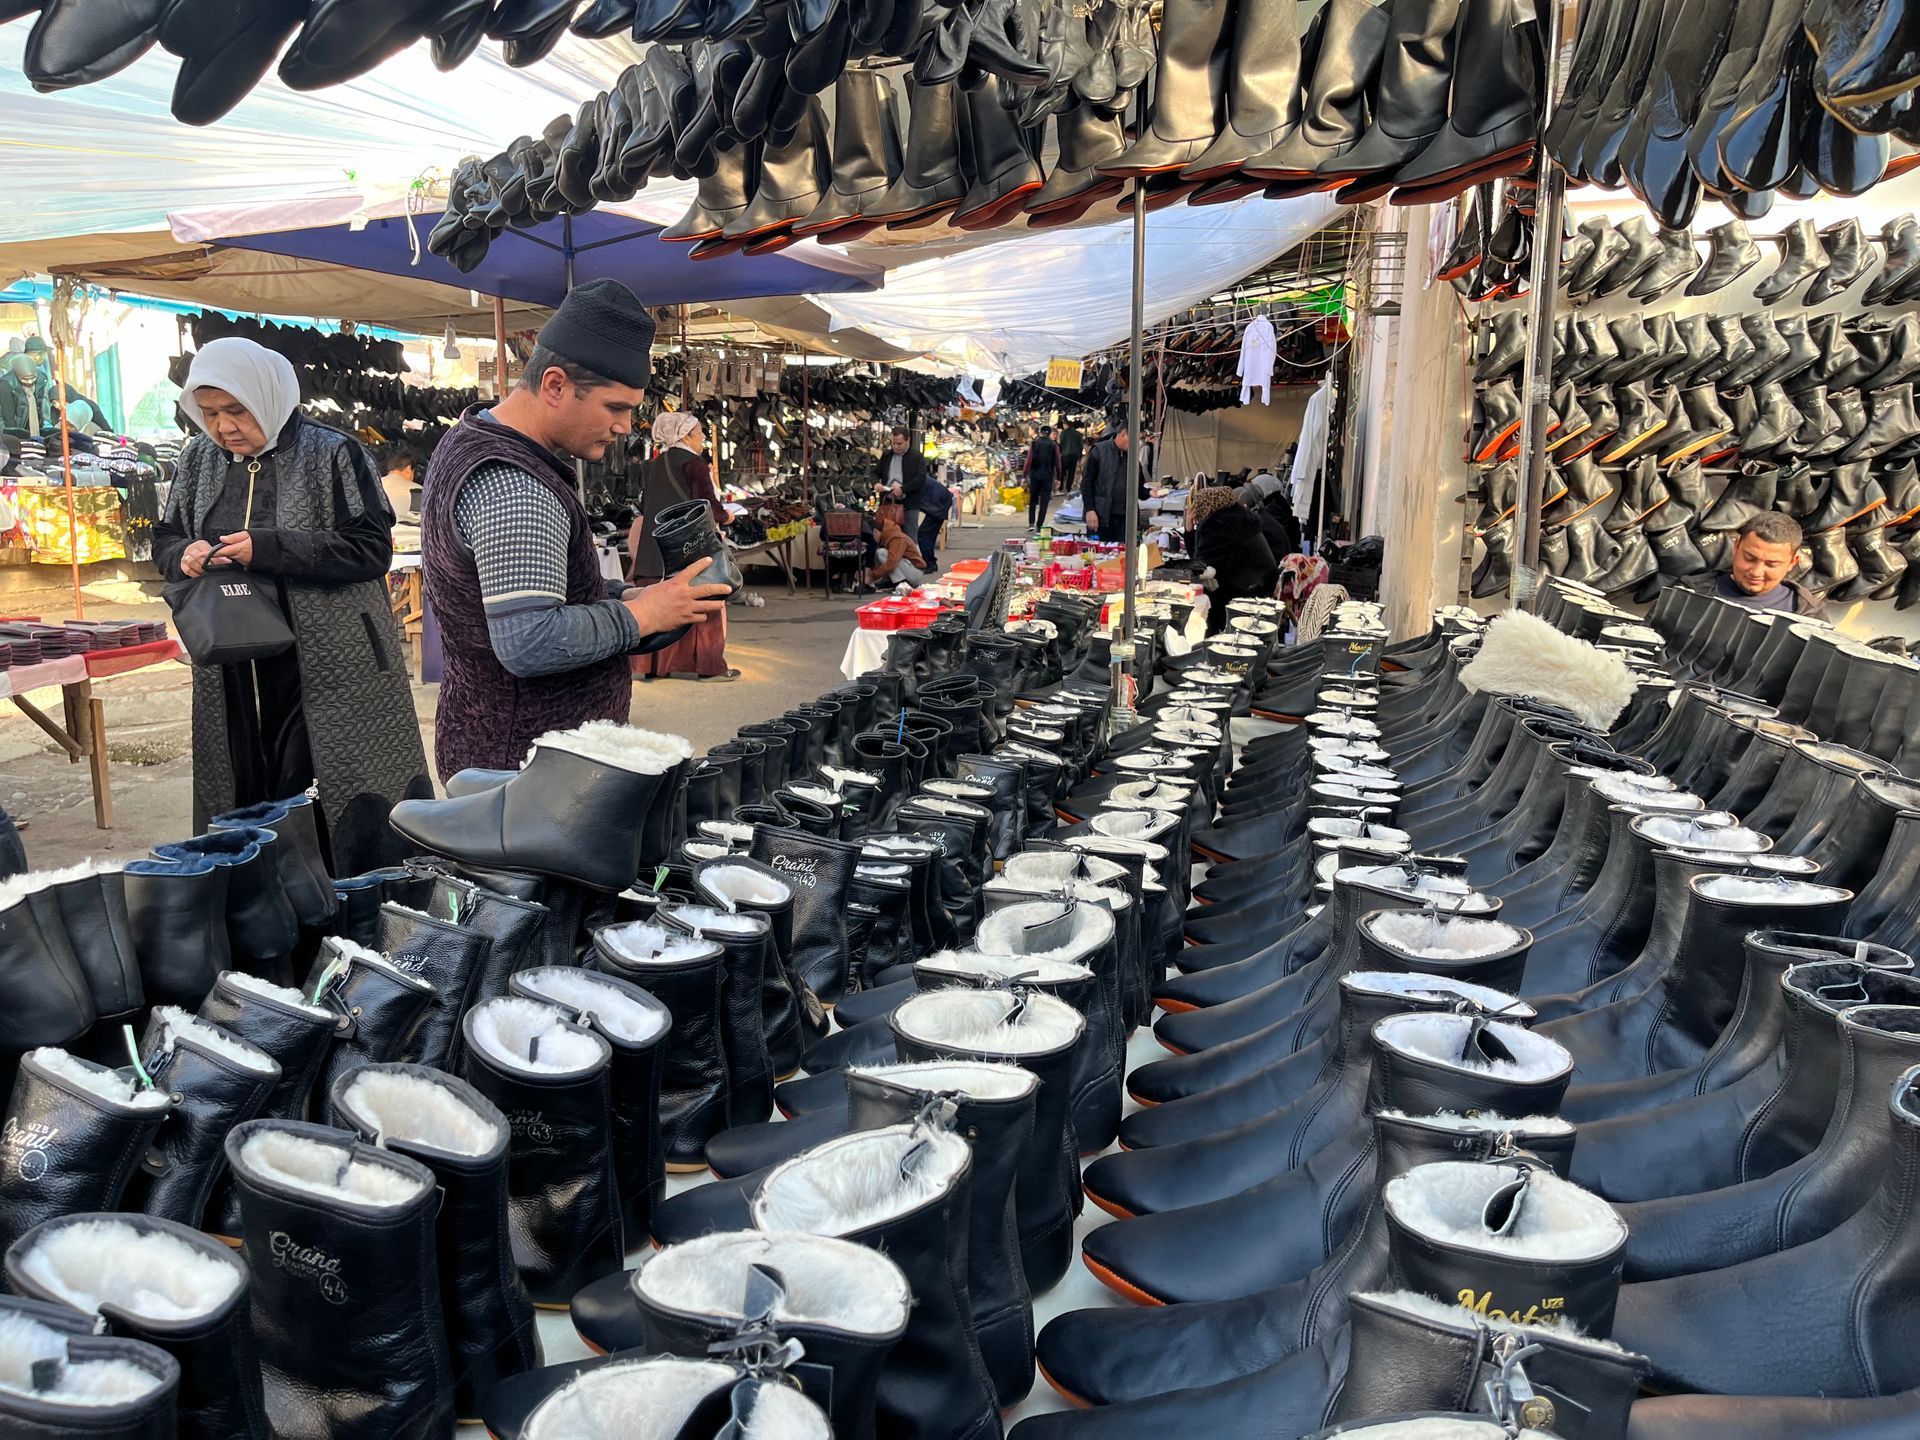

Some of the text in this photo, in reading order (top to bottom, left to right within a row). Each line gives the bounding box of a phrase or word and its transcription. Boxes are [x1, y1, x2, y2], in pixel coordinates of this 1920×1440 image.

[220, 583, 252, 597] ELBE
[771, 855, 819, 872] Grand
[28, 1122, 50, 1134] UZB
